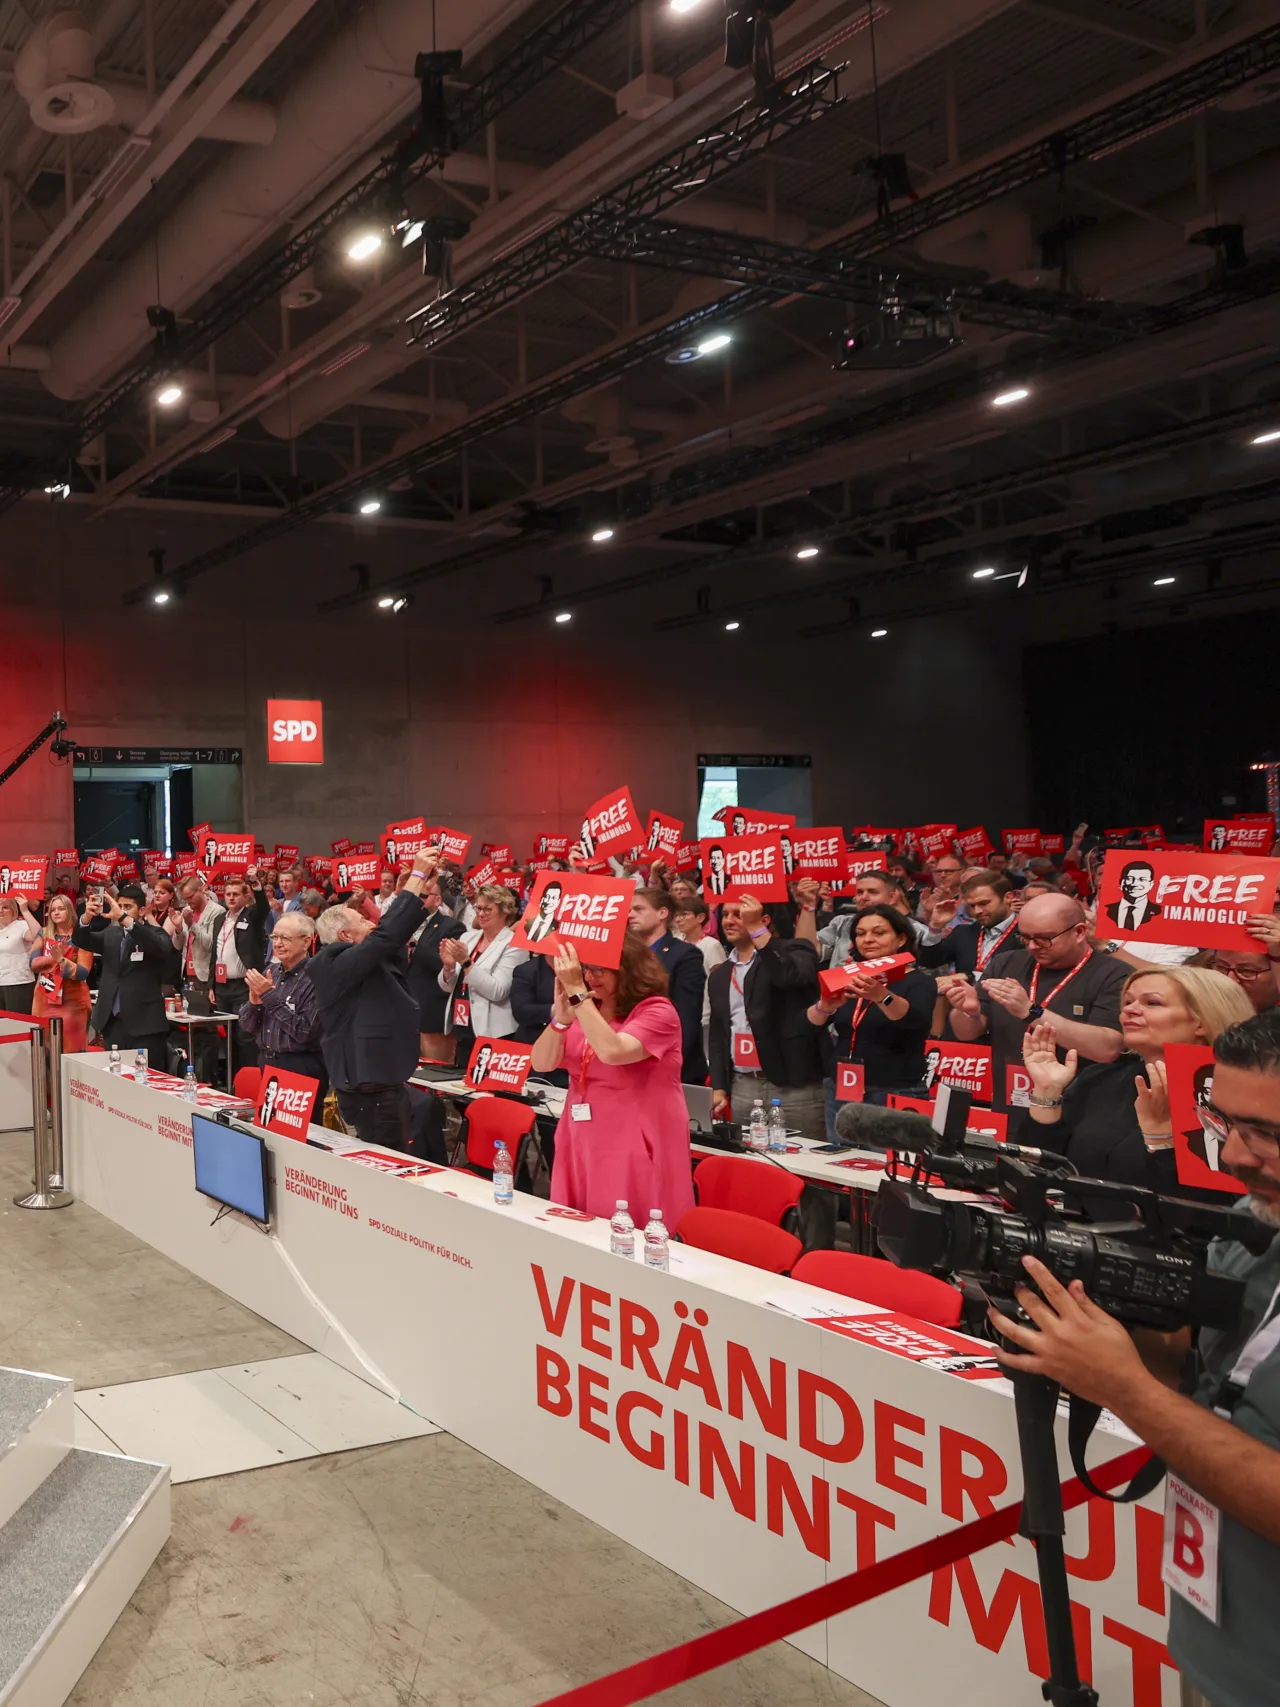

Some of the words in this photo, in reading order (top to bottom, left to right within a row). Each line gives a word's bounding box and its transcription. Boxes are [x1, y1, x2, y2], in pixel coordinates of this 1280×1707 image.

[272, 719, 318, 742] SPD
[590, 798, 629, 837] FREE
[546, 837, 568, 847] FREE
[597, 821, 632, 844] IMAMOGLU
[658, 826, 681, 845] FREE
[959, 831, 983, 848] FREE
[1012, 833, 1037, 844] FREE
[1226, 828, 1268, 842] FREE
[217, 841, 251, 856] FREE
[396, 839, 428, 856] FREE
[445, 836, 468, 850] FREE
[793, 837, 839, 860] FREE
[95, 863, 112, 873] FREE
[347, 860, 377, 876] FREE
[726, 845, 776, 874] FREE
[799, 858, 838, 868] IMAMOGLU
[10, 869, 42, 883] FREE
[474, 863, 493, 883] FREE
[504, 877, 521, 888] REE
[731, 873, 774, 885] IMAMOGLU
[1155, 873, 1265, 904] FREE
[557, 893, 625, 923] FREE
[1163, 905, 1248, 926] IMAMOGLU
[558, 921, 610, 943] IMAMOGLU
[218, 966, 224, 976] D
[740, 1039, 754, 1055] D
[487, 1052, 531, 1072] FREE
[938, 1056, 990, 1078] FREE
[488, 1070, 520, 1085] IMAMOGLU
[843, 1070, 857, 1087] D
[940, 1076, 982, 1092] IMAMOGLU
[1013, 1073, 1030, 1092] D
[69, 1078, 100, 1098] VERÄNDERUNG
[70, 1087, 87, 1101] BEGINNT
[95, 1099, 105, 1110] UNS
[274, 1087, 313, 1113] FREE
[157, 1114, 193, 1137] VERÄNDERUN
[275, 1108, 304, 1130] IMAMOGLU
[158, 1126, 181, 1143] BEGINNT
[181, 1136, 193, 1149] MIT
[284, 1166, 348, 1202] VERÄNDERUNG
[285, 1179, 319, 1204] BEGINNT
[321, 1194, 337, 1212] MIT
[339, 1202, 359, 1221] UNS
[368, 1217, 381, 1230] SPD
[381, 1222, 408, 1242] SOZIALE
[408, 1234, 435, 1254] POLITIK
[436, 1245, 451, 1260] FÜR
[452, 1252, 474, 1270] DICH.
[1155, 1252, 1193, 1268] SONY
[829, 1320, 947, 1357] FREE
[536, 1343, 896, 1573] BEGINNT
[1169, 1479, 1215, 1521] POOLKARTE
[1173, 1501, 1205, 1579] B
[1187, 1586, 1202, 1603] SPD
